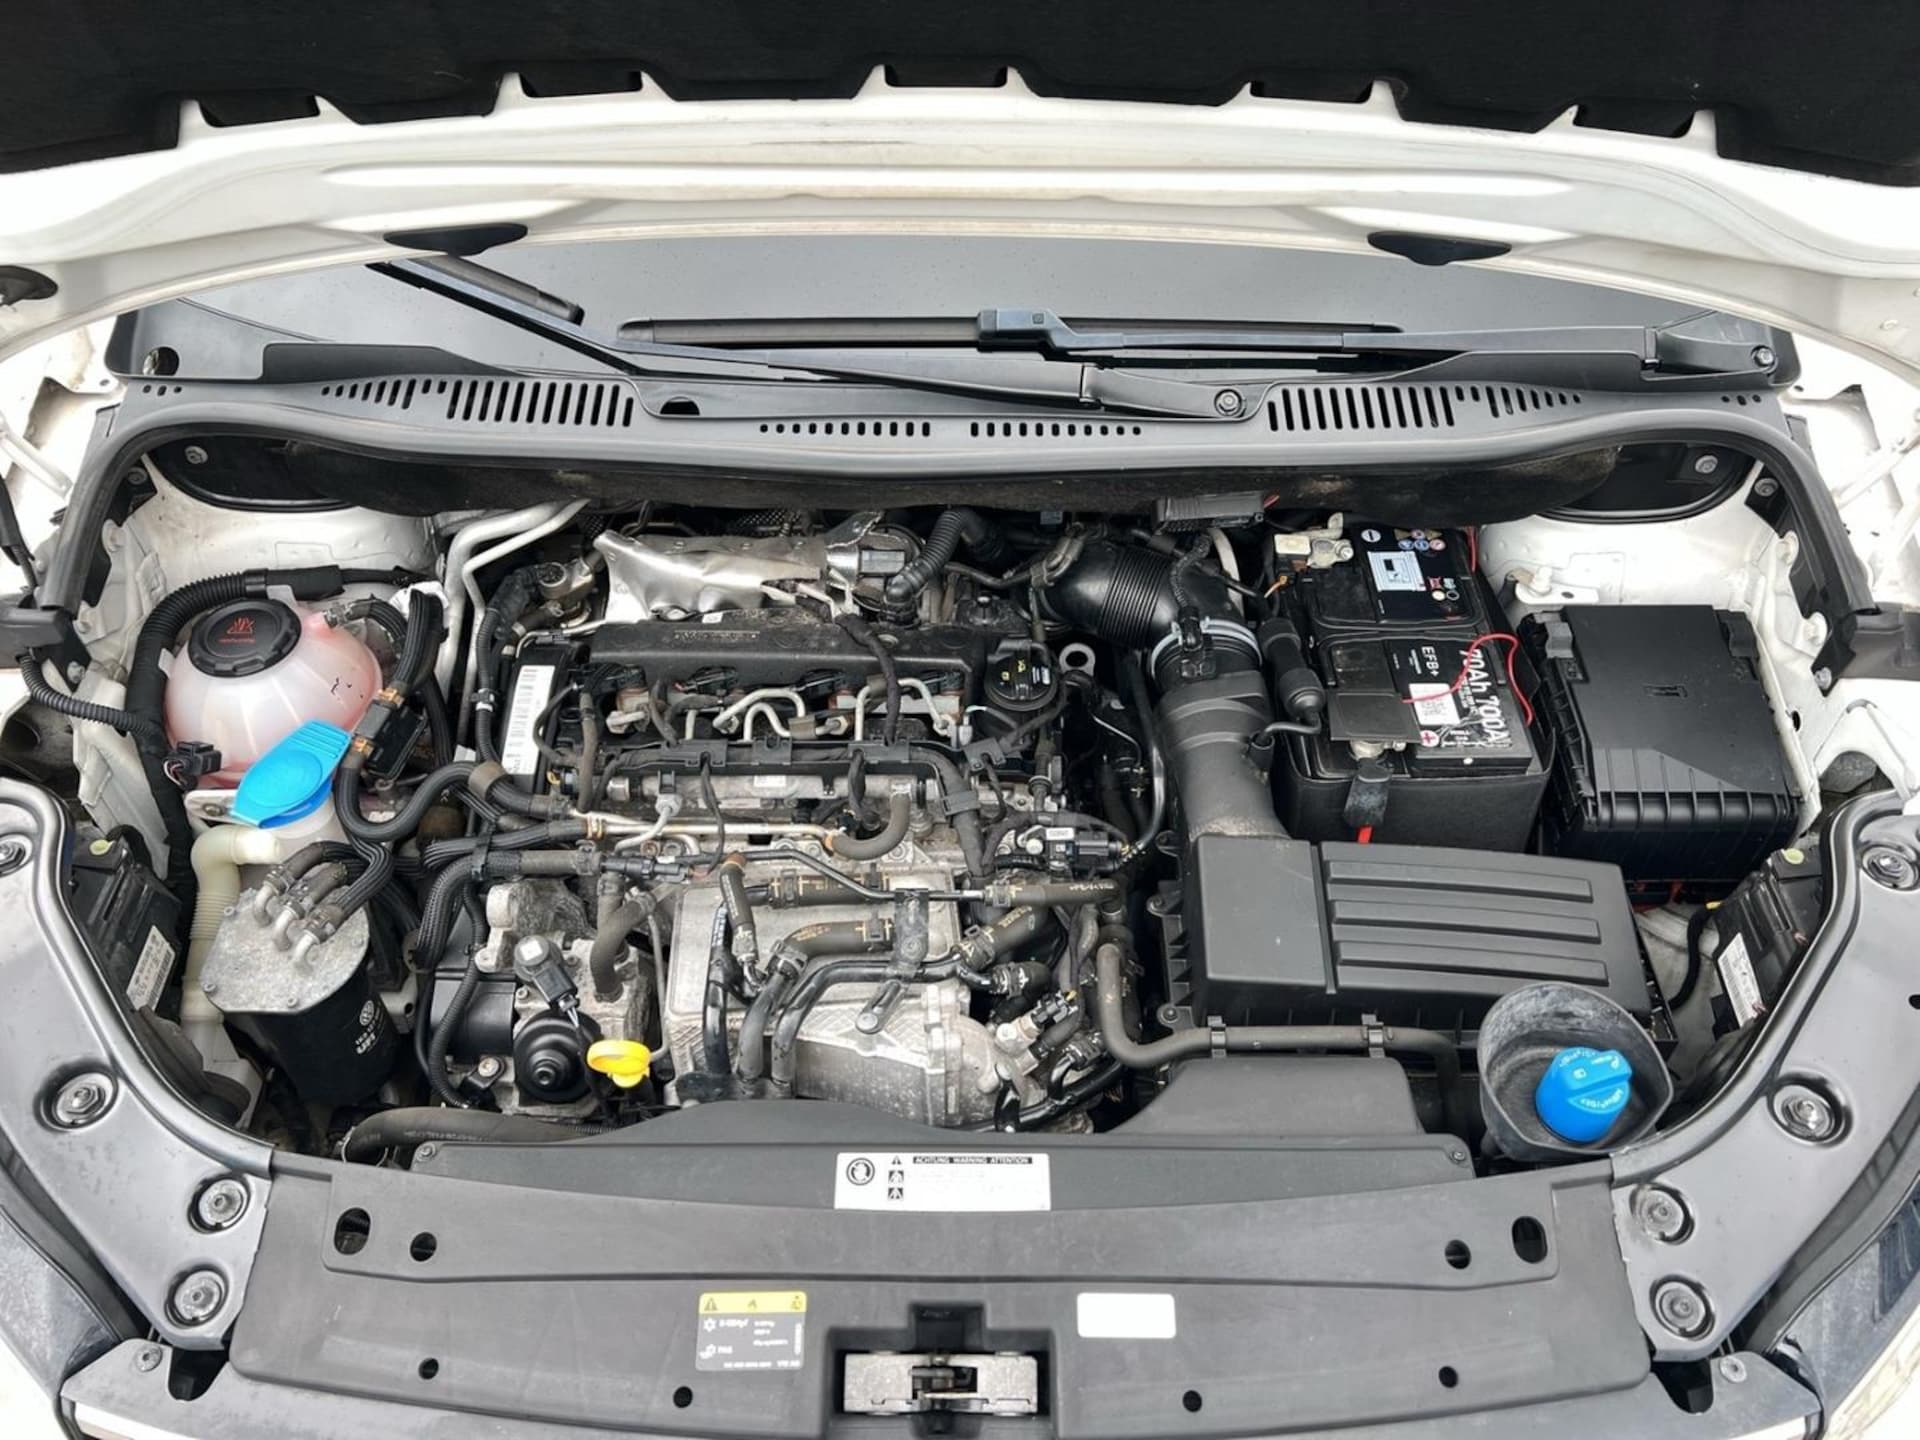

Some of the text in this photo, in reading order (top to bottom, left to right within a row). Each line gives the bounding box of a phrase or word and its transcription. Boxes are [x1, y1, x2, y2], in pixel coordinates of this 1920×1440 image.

[1421, 646, 1439, 677] EFB+
[1460, 649, 1489, 694] 70Ah
[915, 1156, 1029, 1164] ACHTUNG WARNING ATTENTION
